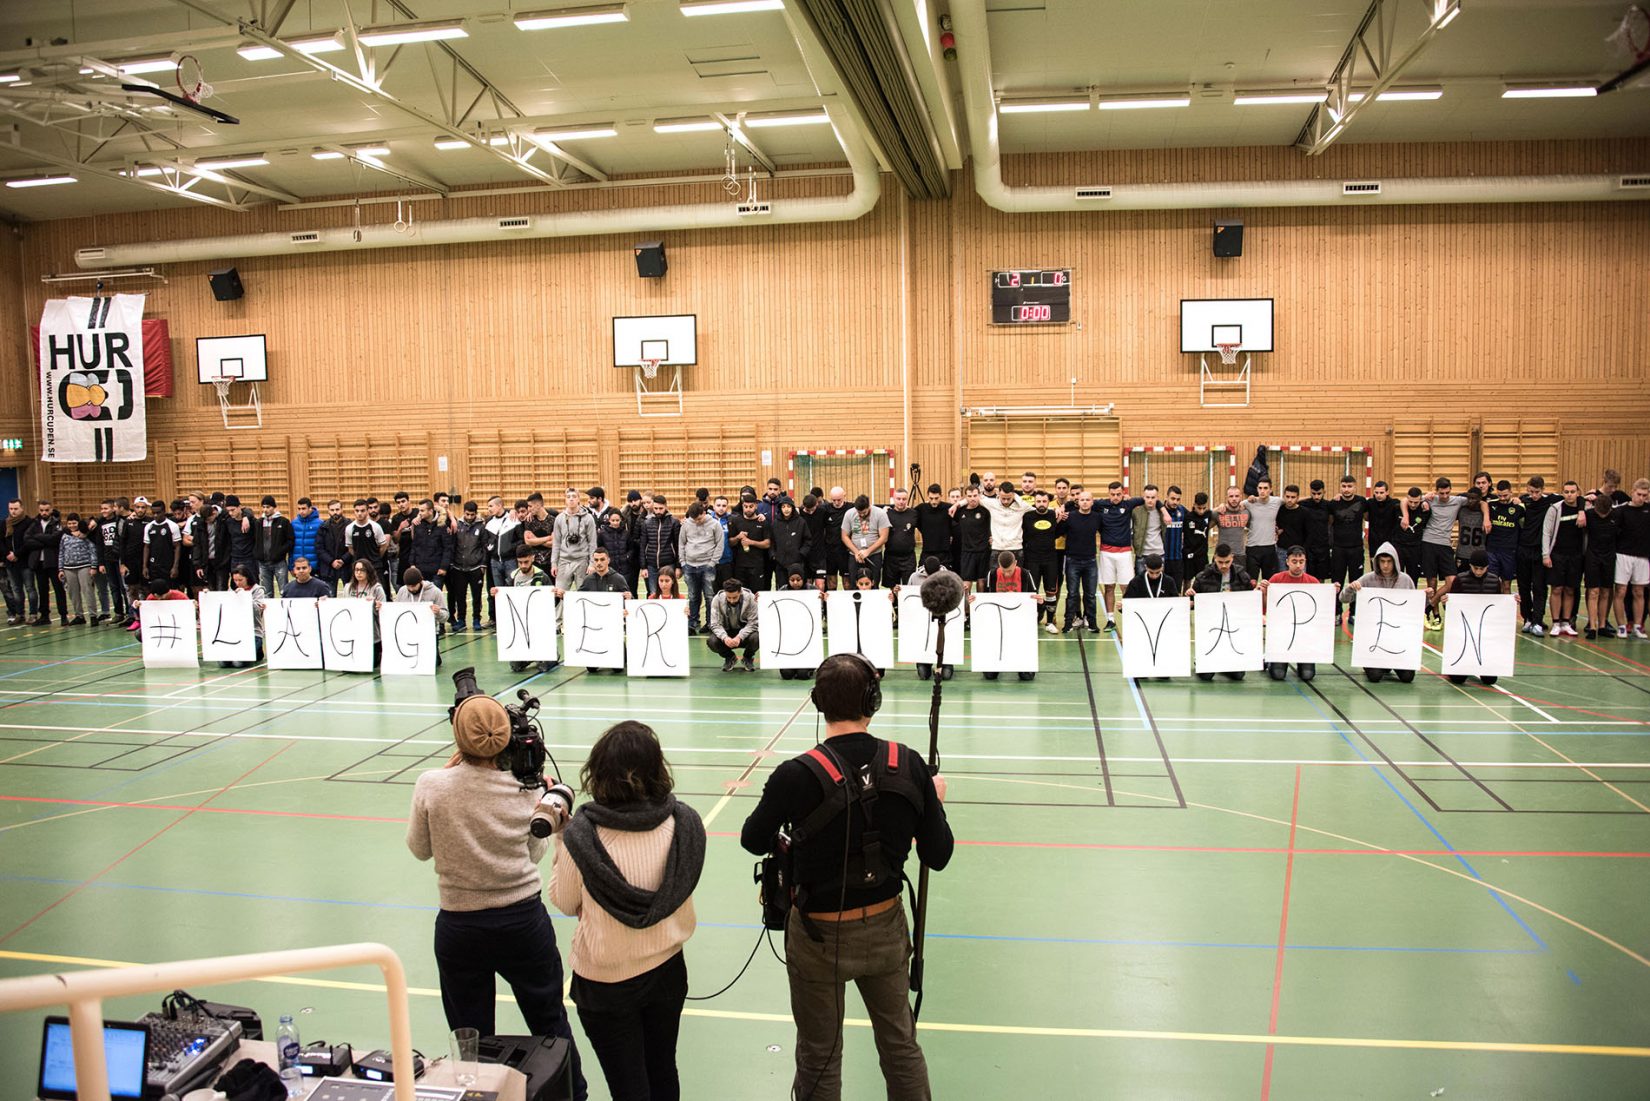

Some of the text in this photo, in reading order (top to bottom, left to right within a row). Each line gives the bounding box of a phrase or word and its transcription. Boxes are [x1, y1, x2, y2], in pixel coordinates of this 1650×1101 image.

[1011, 272, 1020, 286] 2
[1054, 272, 1063, 286] 0
[1021, 306, 1049, 320] 0:00
[48, 332, 134, 370] HUR
[46, 371, 56, 459] WWW.HURCUPEN.SE
[1460, 526, 1482, 546] 66
